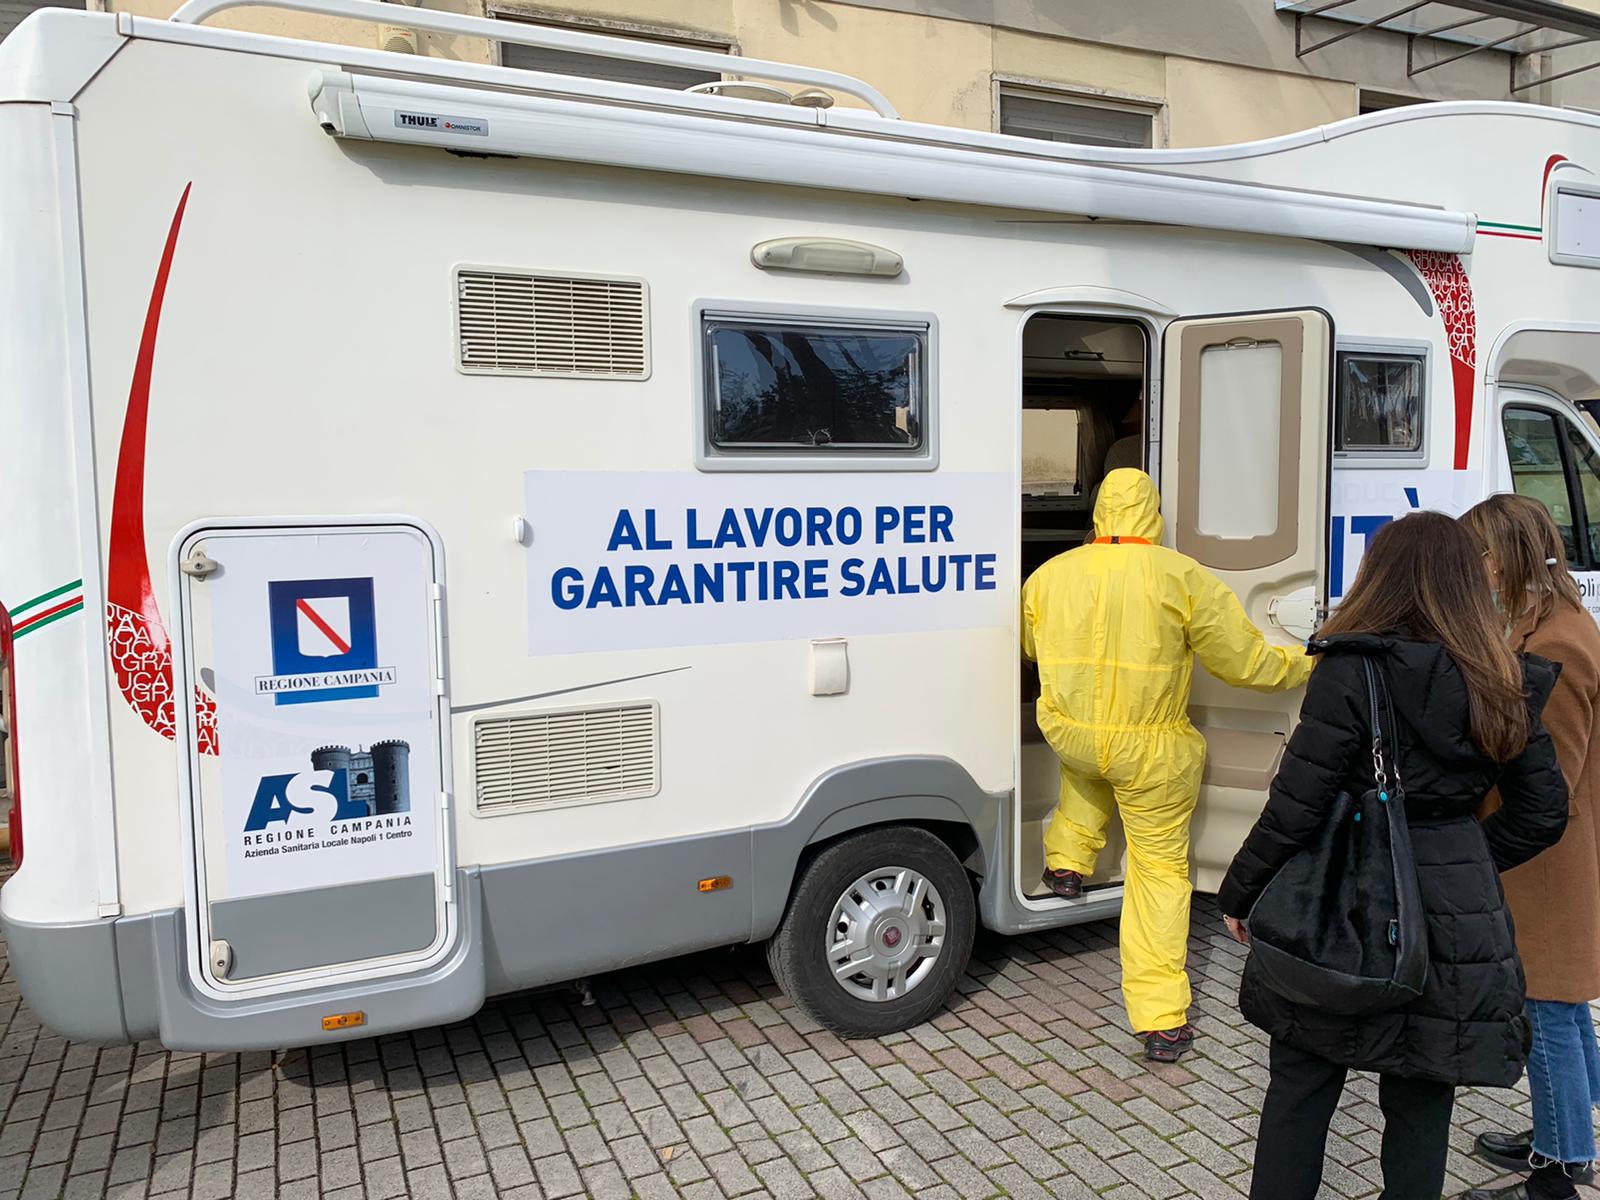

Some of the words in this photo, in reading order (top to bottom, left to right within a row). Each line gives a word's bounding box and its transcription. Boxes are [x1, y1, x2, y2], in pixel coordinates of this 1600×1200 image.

[400, 114, 437, 127] THULE
[607, 509, 673, 551] AL
[687, 506, 862, 549] LAVORO
[875, 505, 954, 544] PER
[551, 559, 829, 610] GARANTIRE
[840, 553, 996, 597] SALUTE
[259, 677, 320, 692] REGIONE
[324, 671, 392, 687] CAMPANIA
[244, 768, 368, 832] ASL
[244, 828, 315, 845] REGIONE
[331, 816, 412, 835] CAMPANIA
[245, 845, 279, 858] Azienda
[282, 839, 320, 853] Sanitaria
[322, 838, 349, 848] Locale
[351, 834, 376, 845] Napoli
[387, 830, 412, 840] Centro
